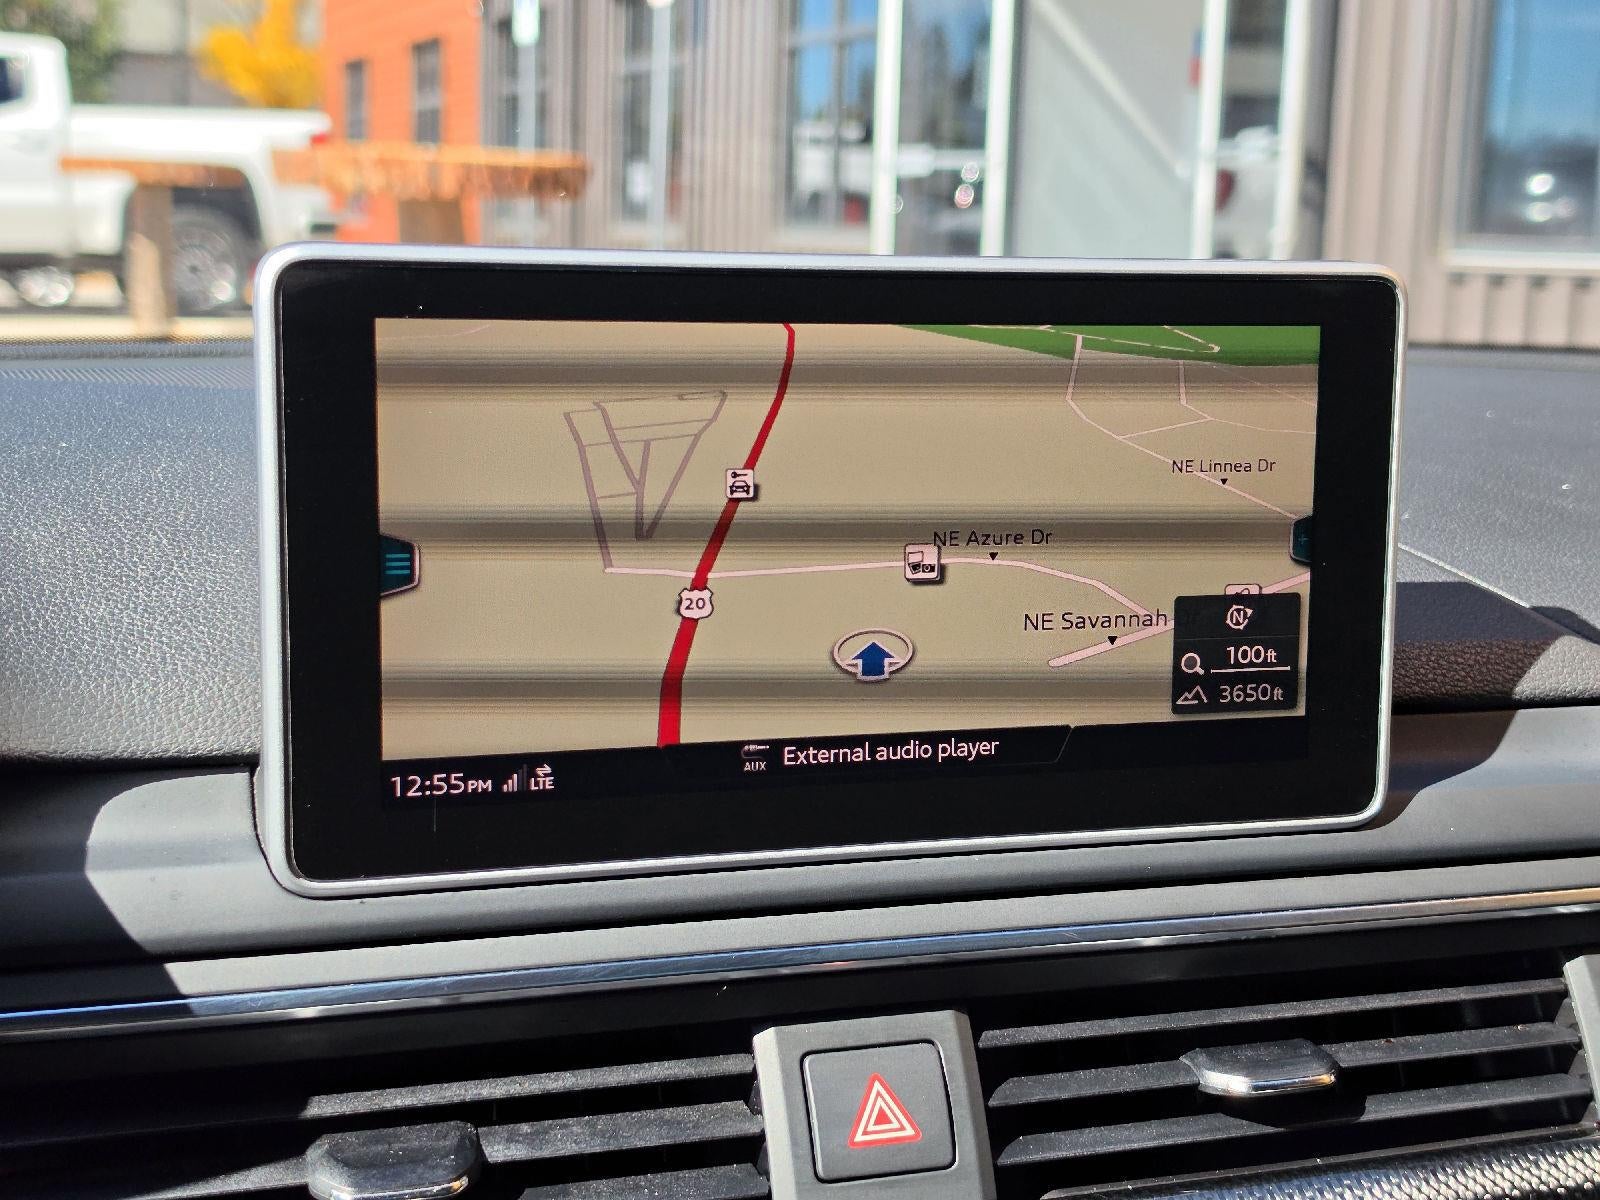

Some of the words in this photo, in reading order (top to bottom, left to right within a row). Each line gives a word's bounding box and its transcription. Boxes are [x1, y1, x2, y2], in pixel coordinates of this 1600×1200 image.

[1171, 459, 1194, 474] NE
[1199, 458, 1252, 473] Linnea
[1257, 458, 1277, 472] Dr
[933, 530, 960, 547] NE
[965, 529, 1025, 547] Azure
[1030, 528, 1053, 545] Dr
[684, 597, 706, 611] 20
[1023, 612, 1054, 632] NE
[1061, 608, 1168, 631] Savannah
[783, 741, 872, 766] External
[875, 739, 933, 761] audio
[938, 737, 1000, 763] player
[743, 761, 767, 772] AUX
[529, 776, 555, 791] LTE
